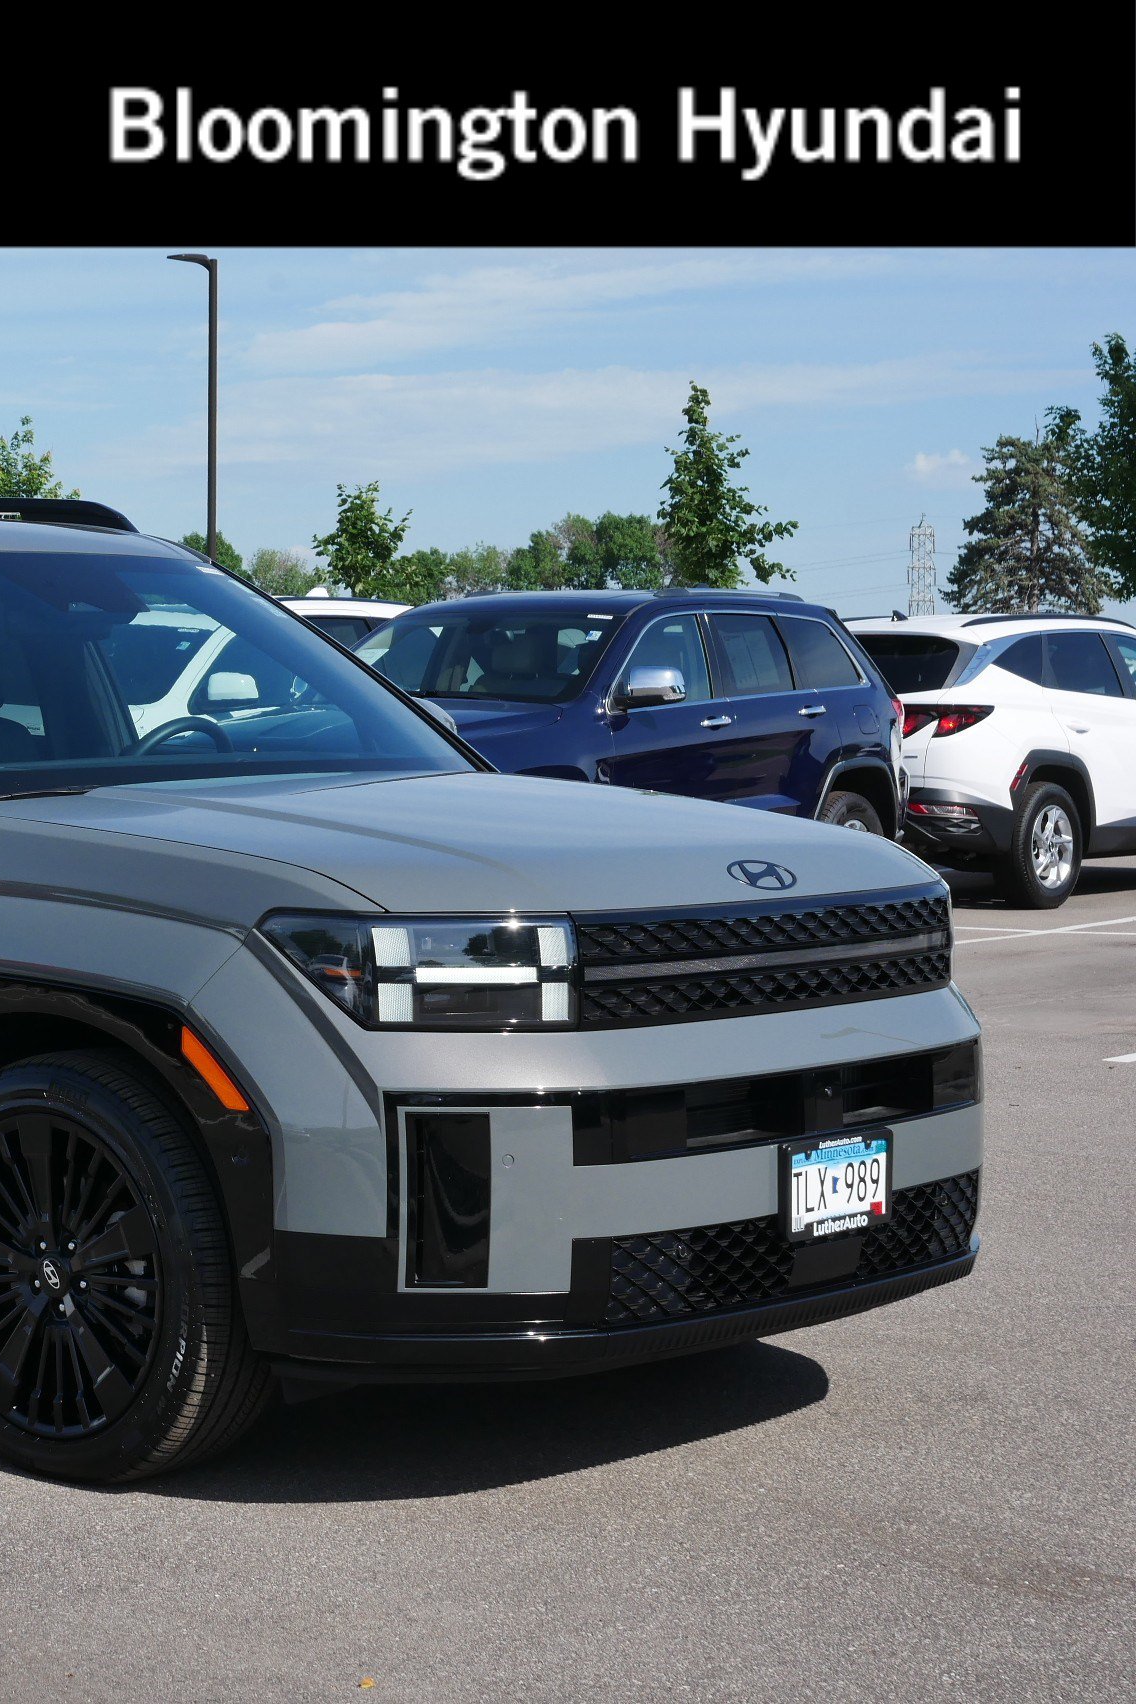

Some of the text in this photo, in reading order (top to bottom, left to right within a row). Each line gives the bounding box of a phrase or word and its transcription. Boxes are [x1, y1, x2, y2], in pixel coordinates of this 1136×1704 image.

[793, 1158, 880, 1216] TLX 989
[813, 1214, 868, 1237] LutherAuto
